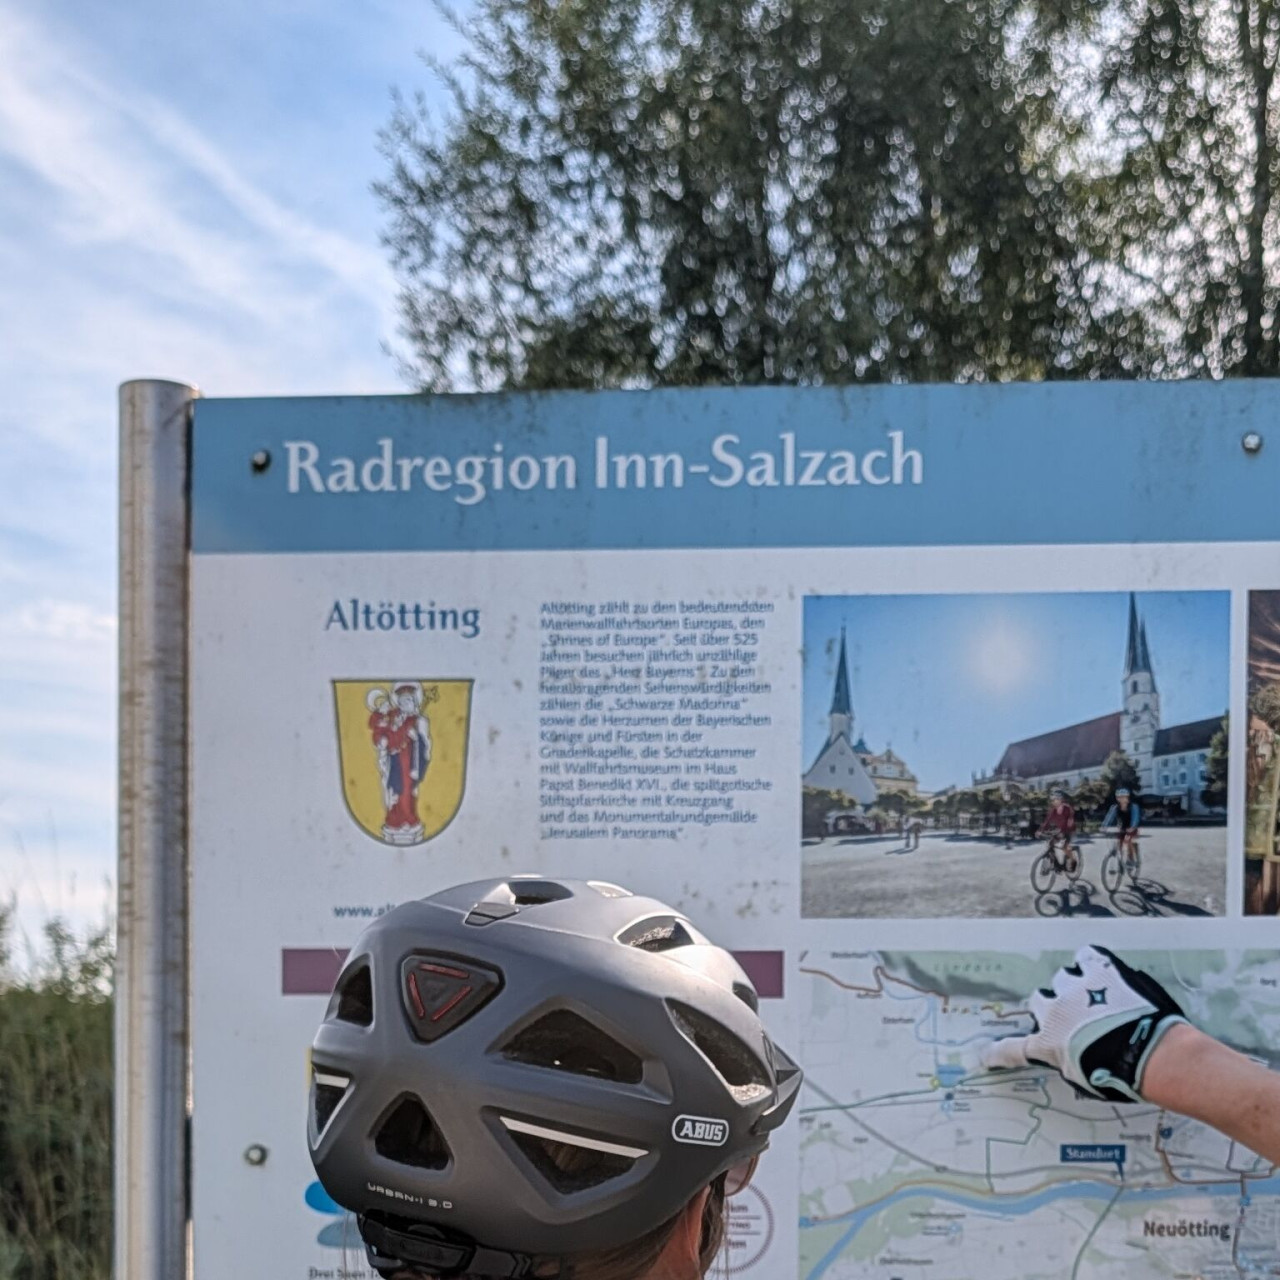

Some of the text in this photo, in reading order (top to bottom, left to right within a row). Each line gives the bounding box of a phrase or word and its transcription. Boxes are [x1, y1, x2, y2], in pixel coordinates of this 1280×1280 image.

[283, 431, 924, 505] Radregion Inn-Salzach
[540, 601, 595, 615] Altötting
[325, 599, 481, 638] Altötting
[734, 634, 758, 645] 525
[680, 1121, 723, 1141] ABUS
[1143, 1221, 1231, 1241] Neuötting
